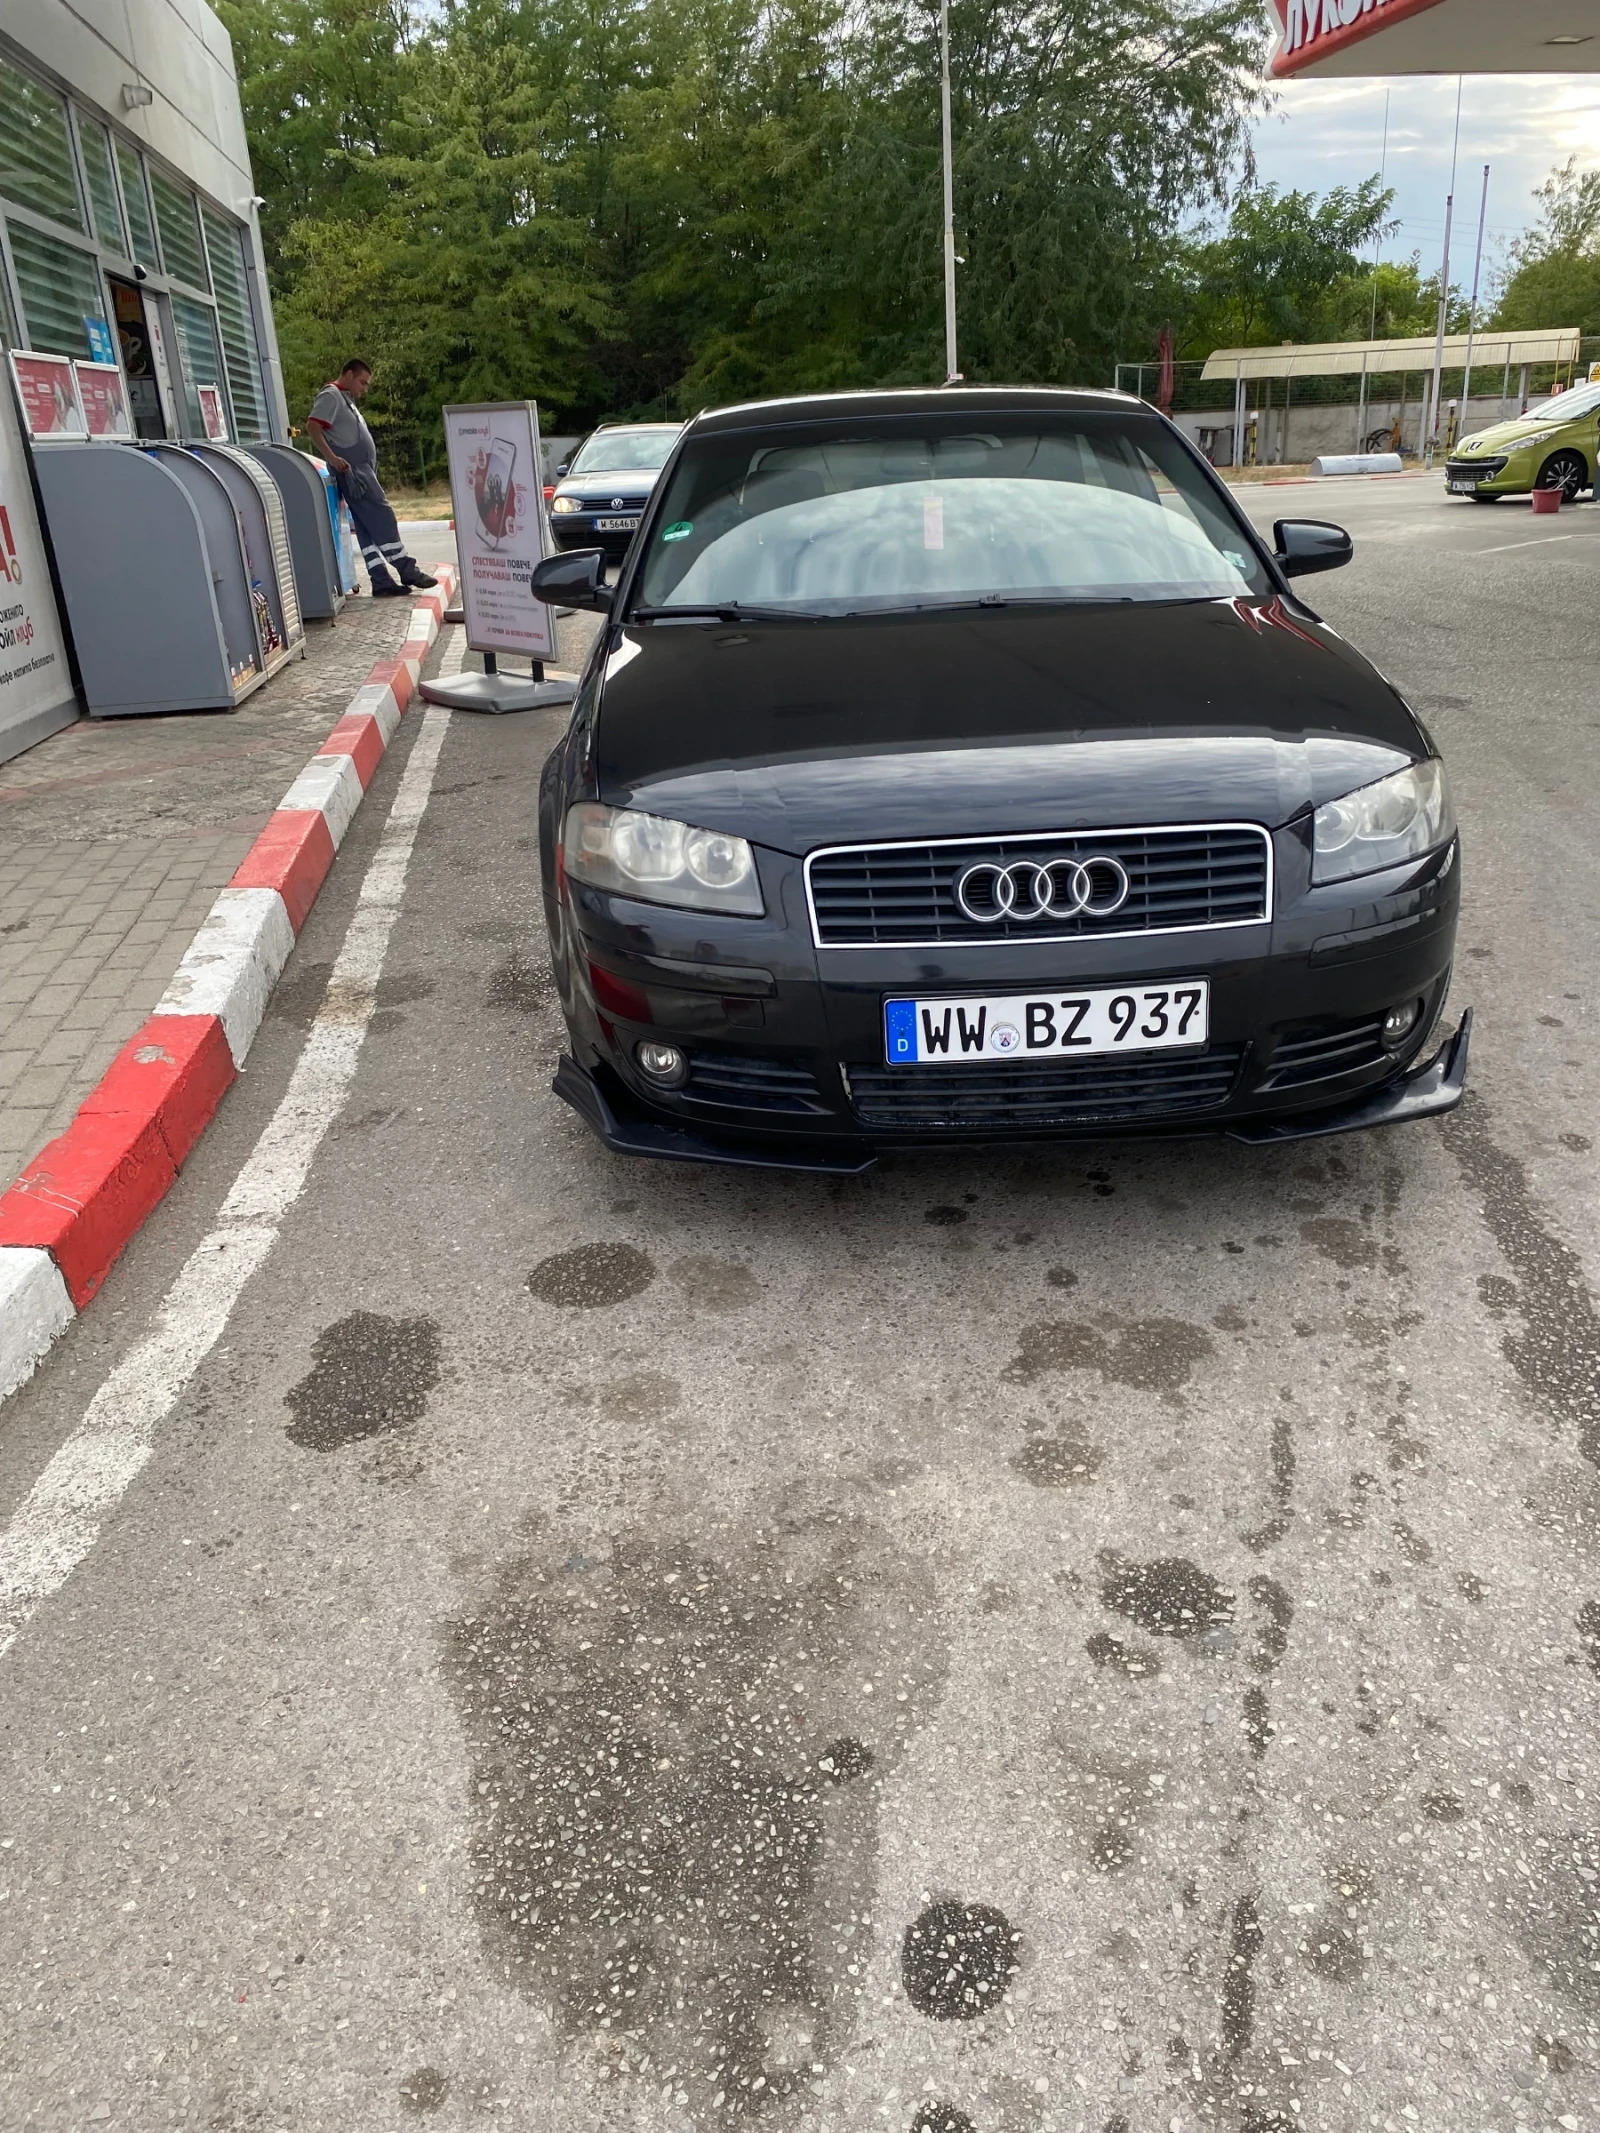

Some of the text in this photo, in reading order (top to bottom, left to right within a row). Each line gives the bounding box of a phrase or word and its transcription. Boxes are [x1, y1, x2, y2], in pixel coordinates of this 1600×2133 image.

[473, 569, 512, 581] ПОЛУЧАВАШ
[15, 616, 34, 646] клуб
[897, 1038, 909, 1052] D
[921, 1005, 987, 1054] WW
[1025, 999, 1093, 1049] BZ
[1108, 989, 1202, 1042] 937
